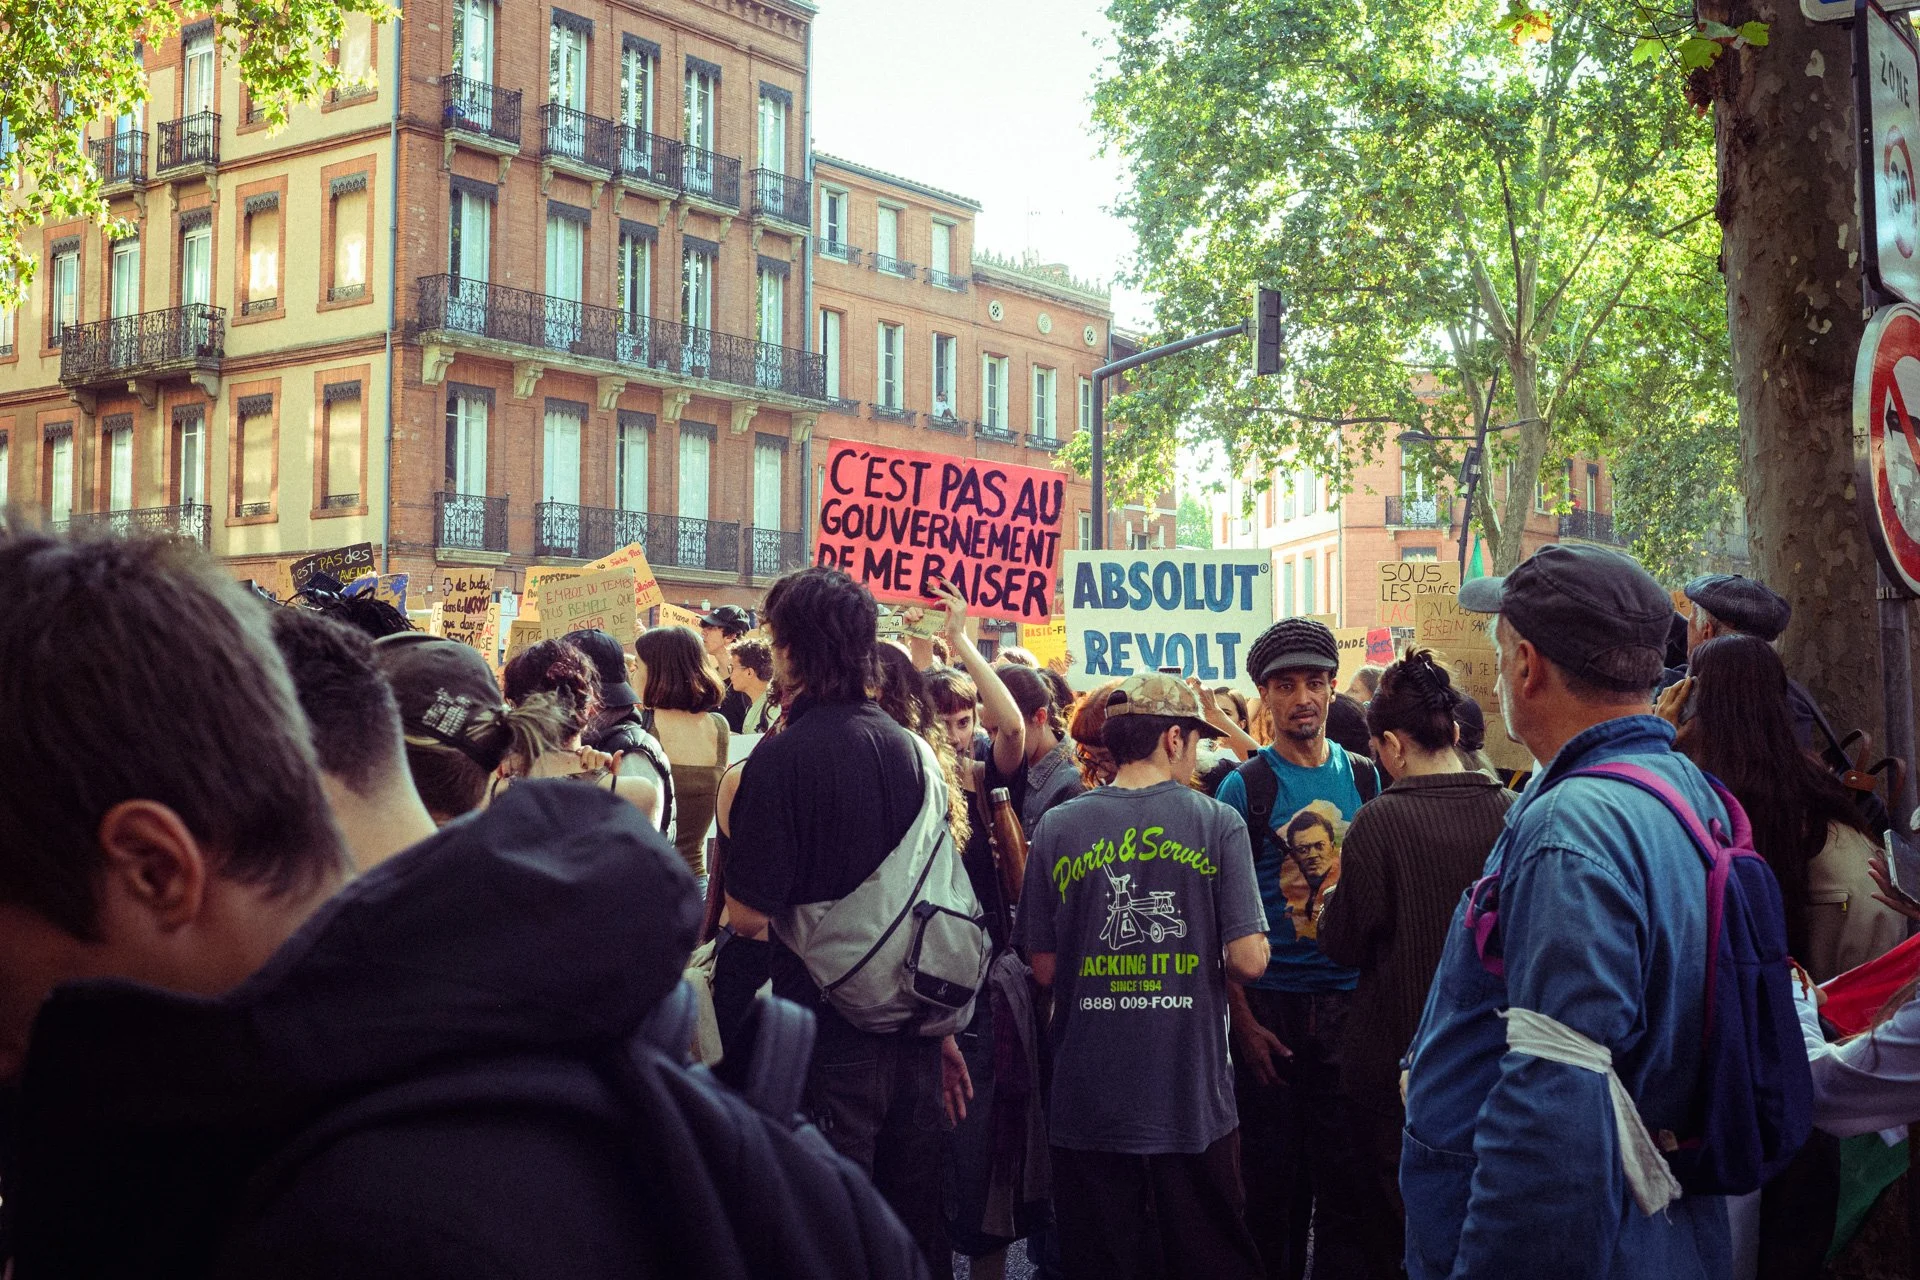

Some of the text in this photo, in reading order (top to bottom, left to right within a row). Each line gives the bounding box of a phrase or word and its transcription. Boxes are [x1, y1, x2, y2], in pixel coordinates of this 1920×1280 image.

[1879, 49, 1910, 109] ZONE
[830, 448, 1064, 526] C'EST PAS AU
[821, 498, 1061, 569] GOUVERNEMENT
[318, 553, 343, 570] PAS
[344, 548, 370, 564] des
[862, 547, 914, 591] ME
[919, 553, 1049, 617] BAISER
[1381, 563, 1442, 583] SOUS
[455, 577, 467, 593] de
[546, 578, 632, 604] EMPLOI DU TEMPS
[1381, 583, 1411, 602] LES
[541, 605, 563, 621] PLUS
[568, 599, 611, 616] REMPLI
[616, 593, 635, 607] QUE
[1421, 602, 1442, 618] ON
[442, 620, 456, 634] que
[567, 616, 605, 632] CASIER
[612, 612, 627, 626] DE
[1024, 625, 1066, 638] BASIC-FI
[1422, 619, 1466, 637] SEREIN
[1084, 630, 1242, 680] REVOLT
[1052, 838, 1116, 905] Parts
[1118, 827, 1137, 862] &
[1151, 954, 1170, 975] IT
[1175, 953, 1200, 975] UP
[1110, 979, 1162, 993] SINCE 1994
